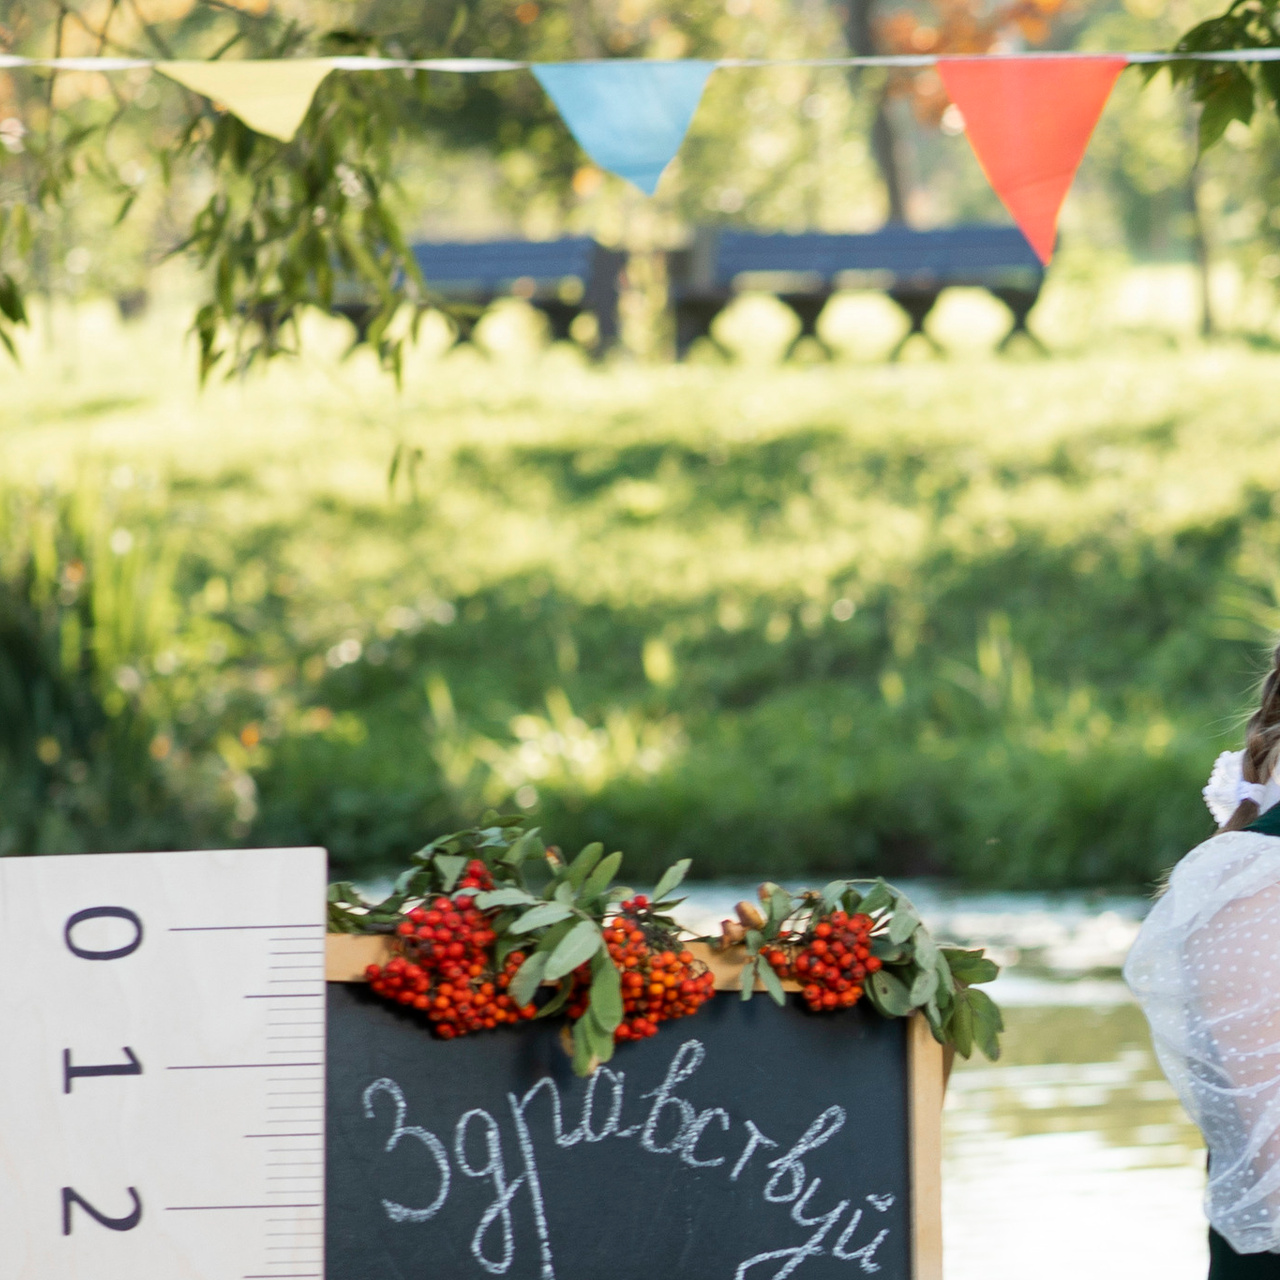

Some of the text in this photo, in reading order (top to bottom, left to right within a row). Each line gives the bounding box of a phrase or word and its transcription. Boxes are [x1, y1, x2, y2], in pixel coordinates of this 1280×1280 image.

[64, 906, 144, 961] 0
[63, 1046, 144, 1094] 1
[62, 1187, 143, 1236] 2
